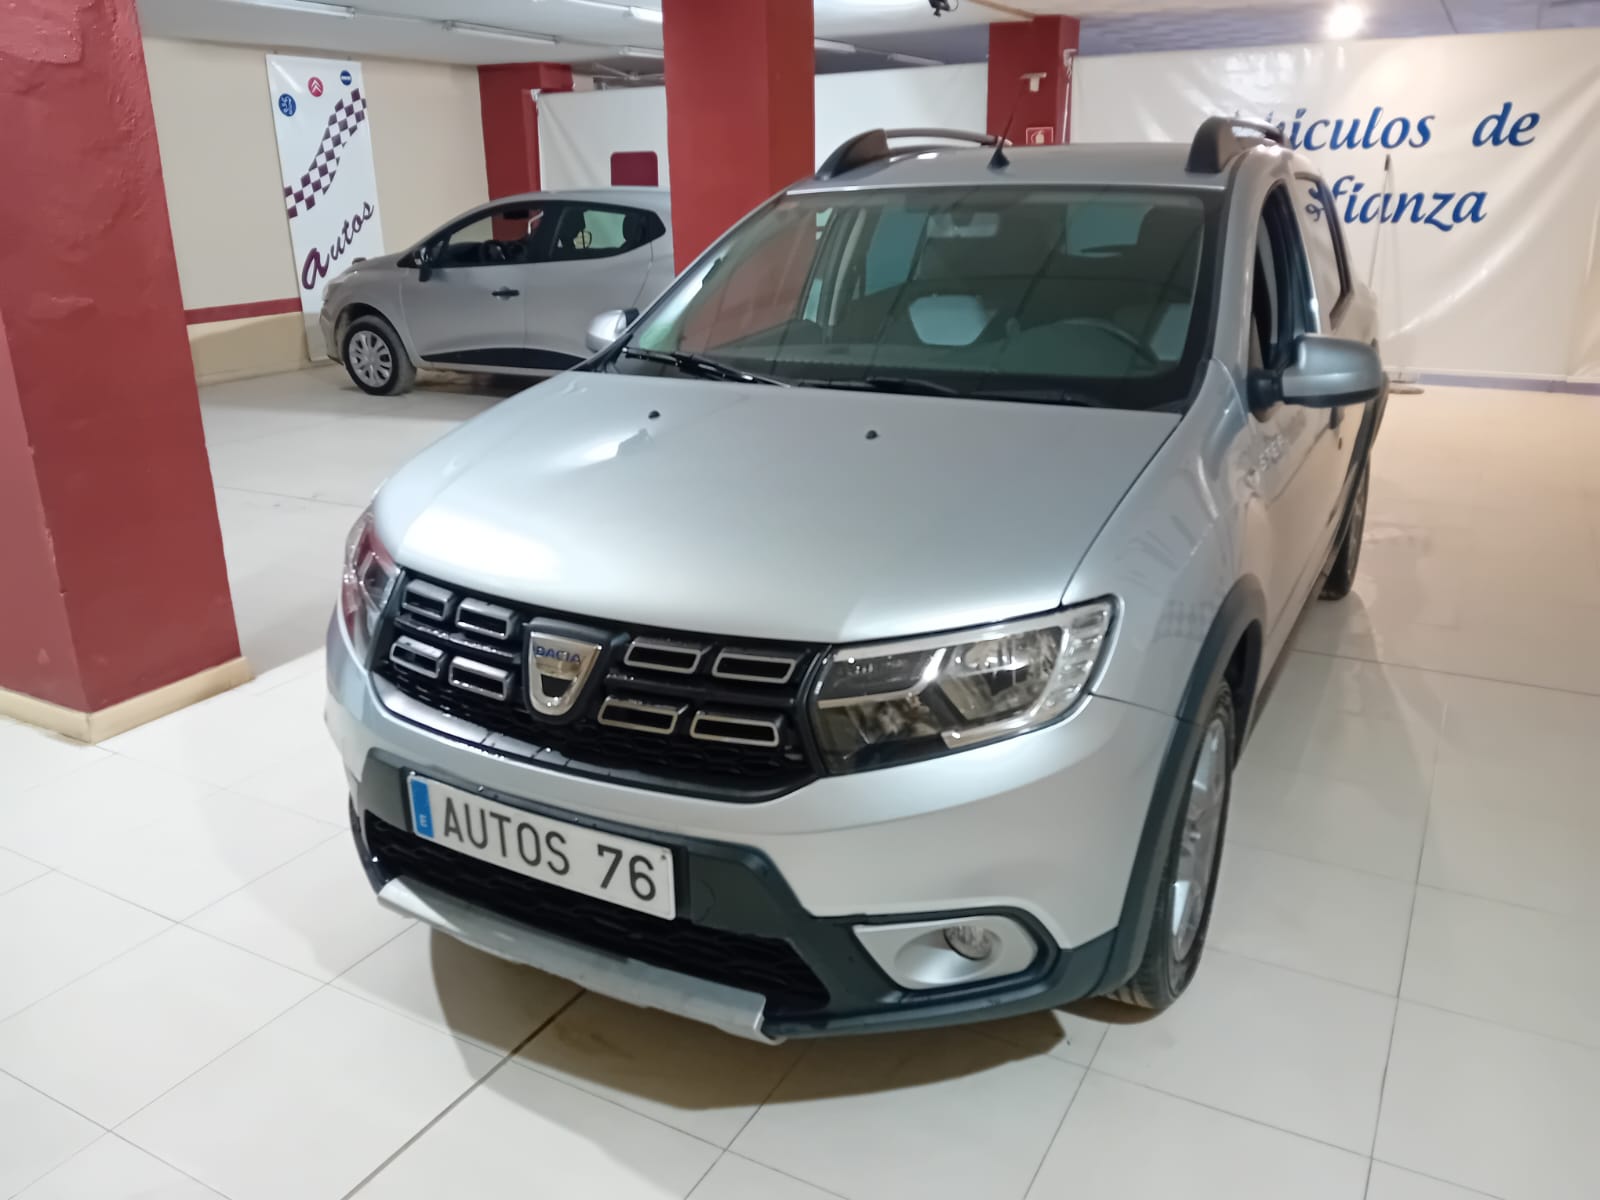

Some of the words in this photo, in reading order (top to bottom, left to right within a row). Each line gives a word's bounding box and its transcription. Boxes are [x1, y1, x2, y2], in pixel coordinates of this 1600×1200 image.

[1472, 101, 1540, 147] de
[1331, 175, 1487, 232] fianza
[535, 646, 582, 664] DACIA
[419, 813, 428, 828] E
[444, 797, 570, 876] AUTOS
[597, 843, 657, 902] 76
